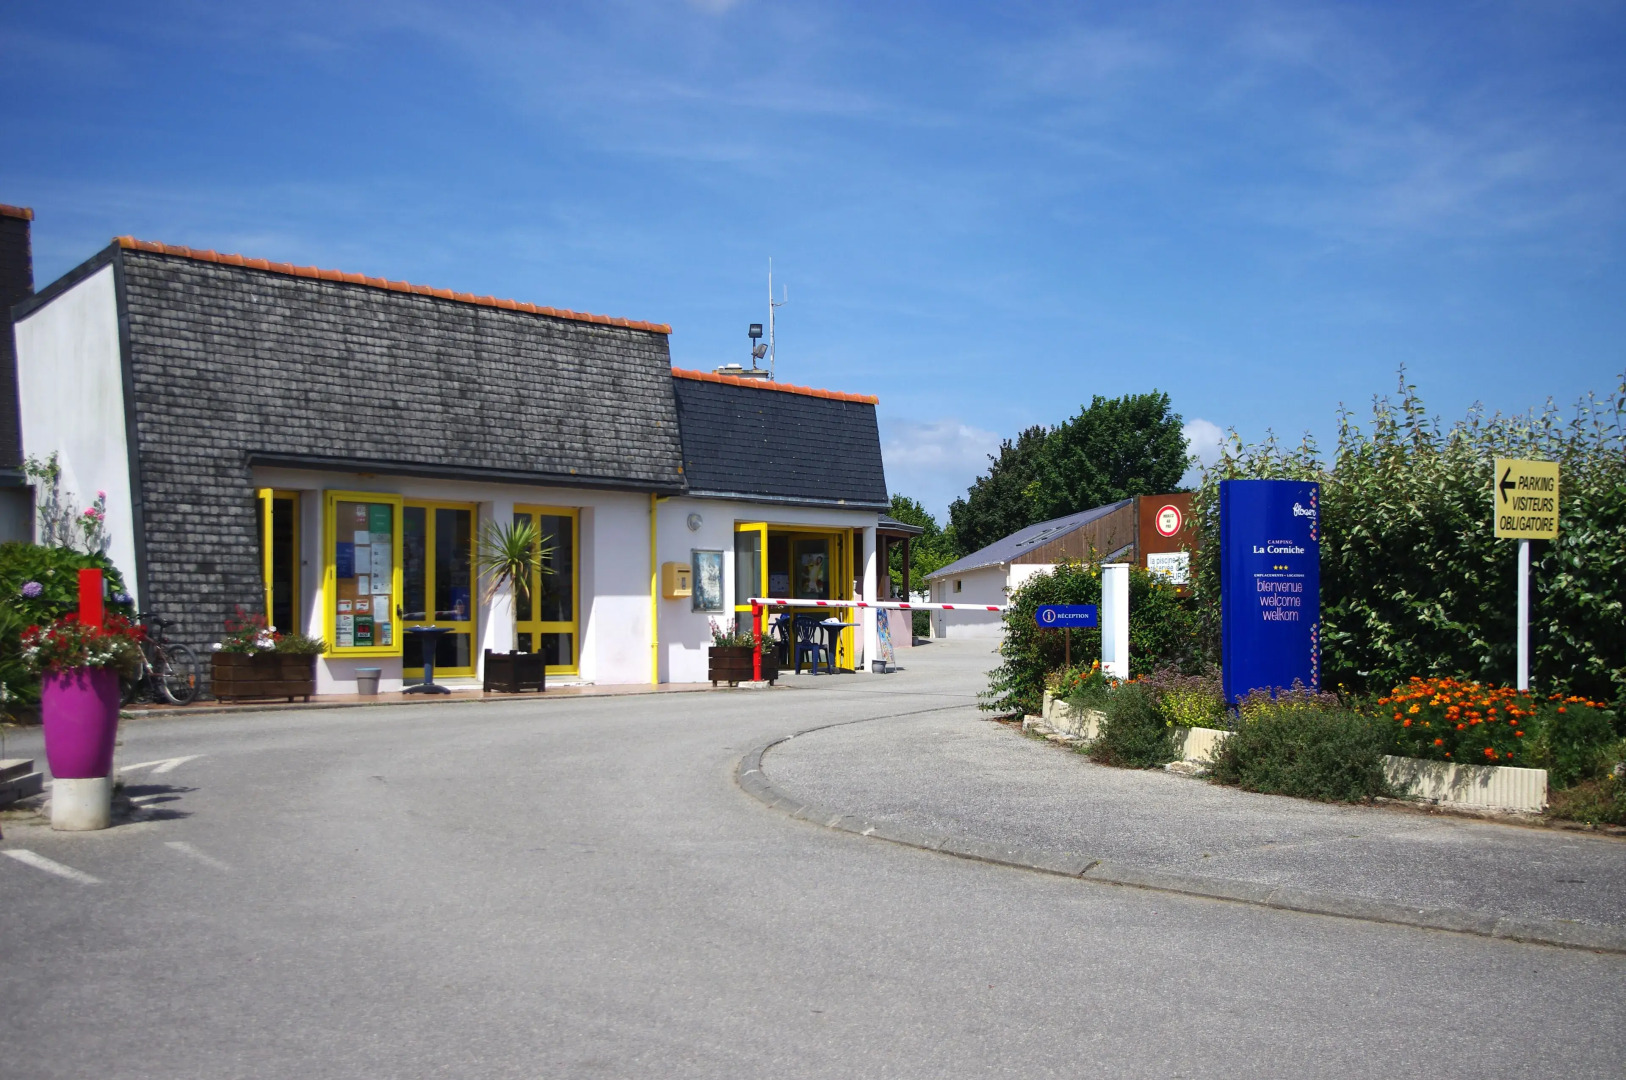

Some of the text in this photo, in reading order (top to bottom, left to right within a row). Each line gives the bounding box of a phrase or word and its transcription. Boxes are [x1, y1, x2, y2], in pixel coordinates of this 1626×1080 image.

[1518, 476, 1554, 491] PARKING
[1513, 497, 1554, 512] VISITEURS
[1500, 515, 1554, 531] OBLIGATOIRE
[1253, 545, 1305, 554] La Corniche
[1257, 578, 1303, 592] bienvenue
[1260, 593, 1301, 607] welcome
[1262, 607, 1299, 621] welkom
